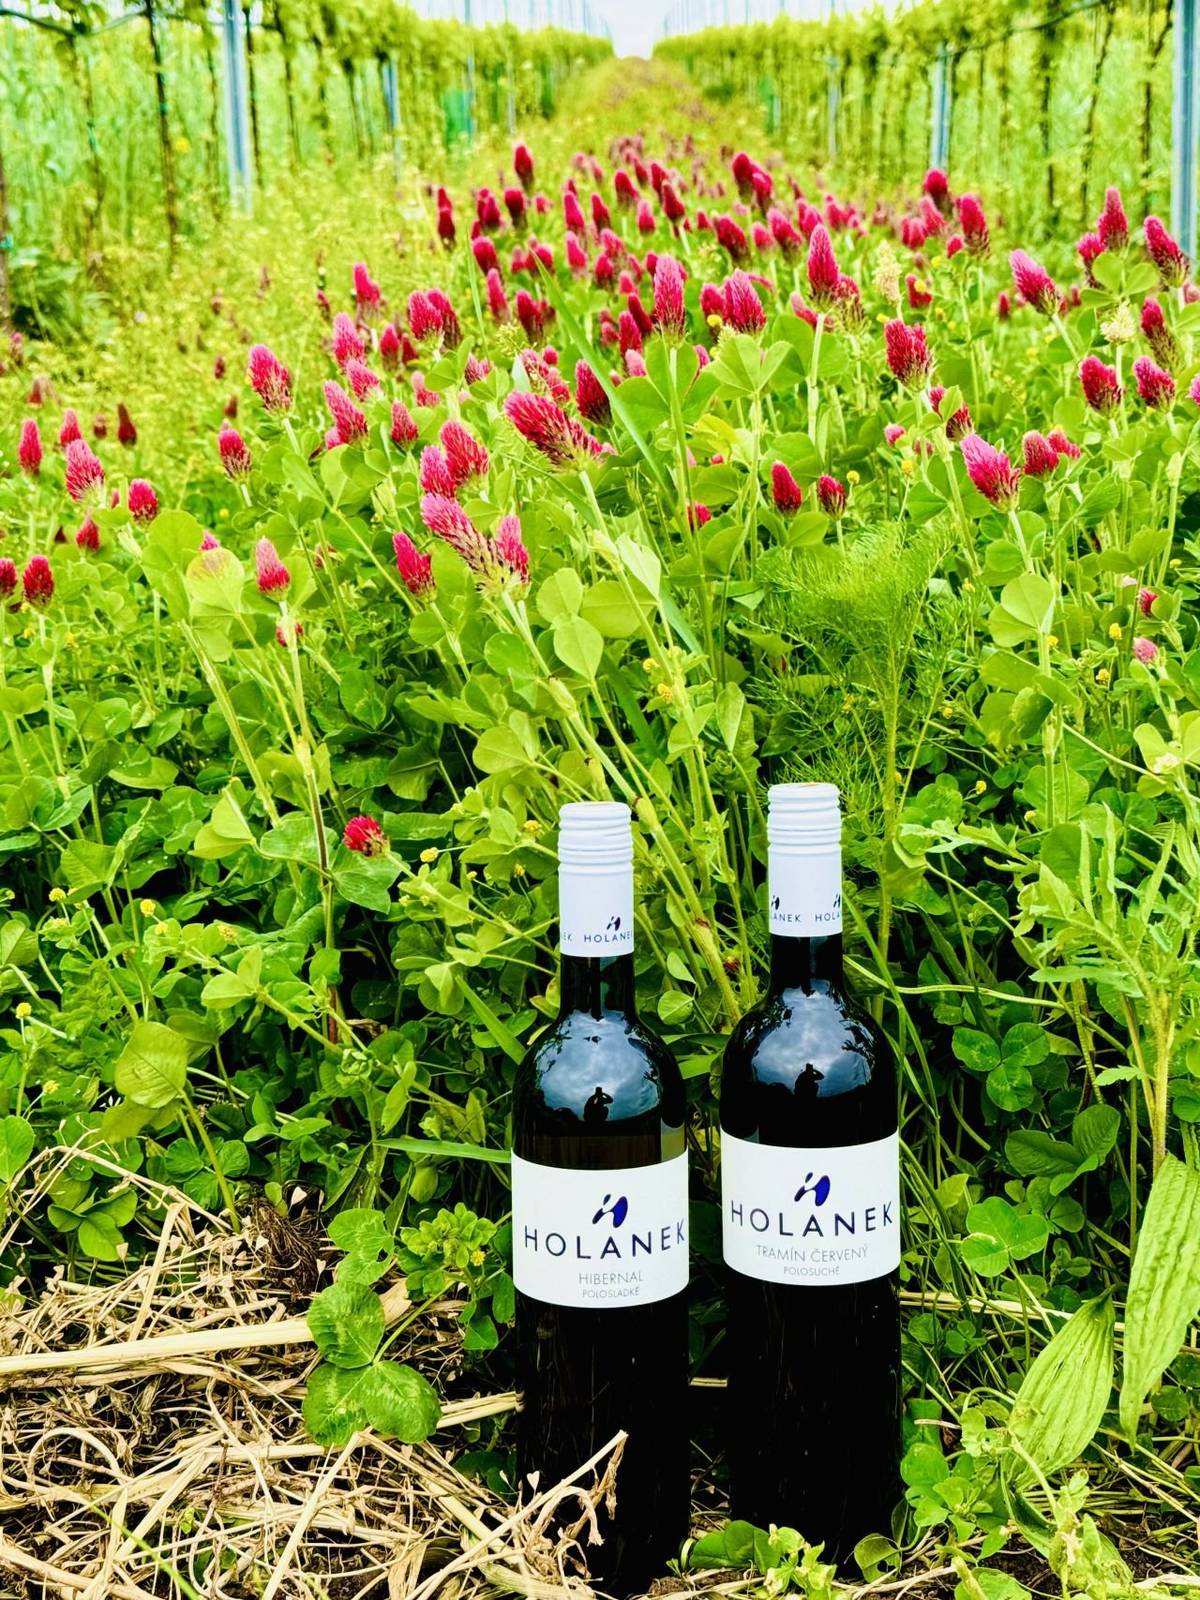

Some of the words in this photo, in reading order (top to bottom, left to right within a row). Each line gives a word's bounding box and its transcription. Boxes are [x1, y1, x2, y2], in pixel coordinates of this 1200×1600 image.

[730, 1200, 893, 1238] HOLANEK
[524, 1220, 686, 1260] HOLANEK
[756, 1244, 806, 1262] TRAMÍN
[810, 1243, 869, 1264] ČERVENÝ
[578, 1270, 644, 1286] HIBERNAL
[783, 1264, 841, 1277] POLOSUCHÉ
[582, 1286, 641, 1299] POLOSLADKÉ
